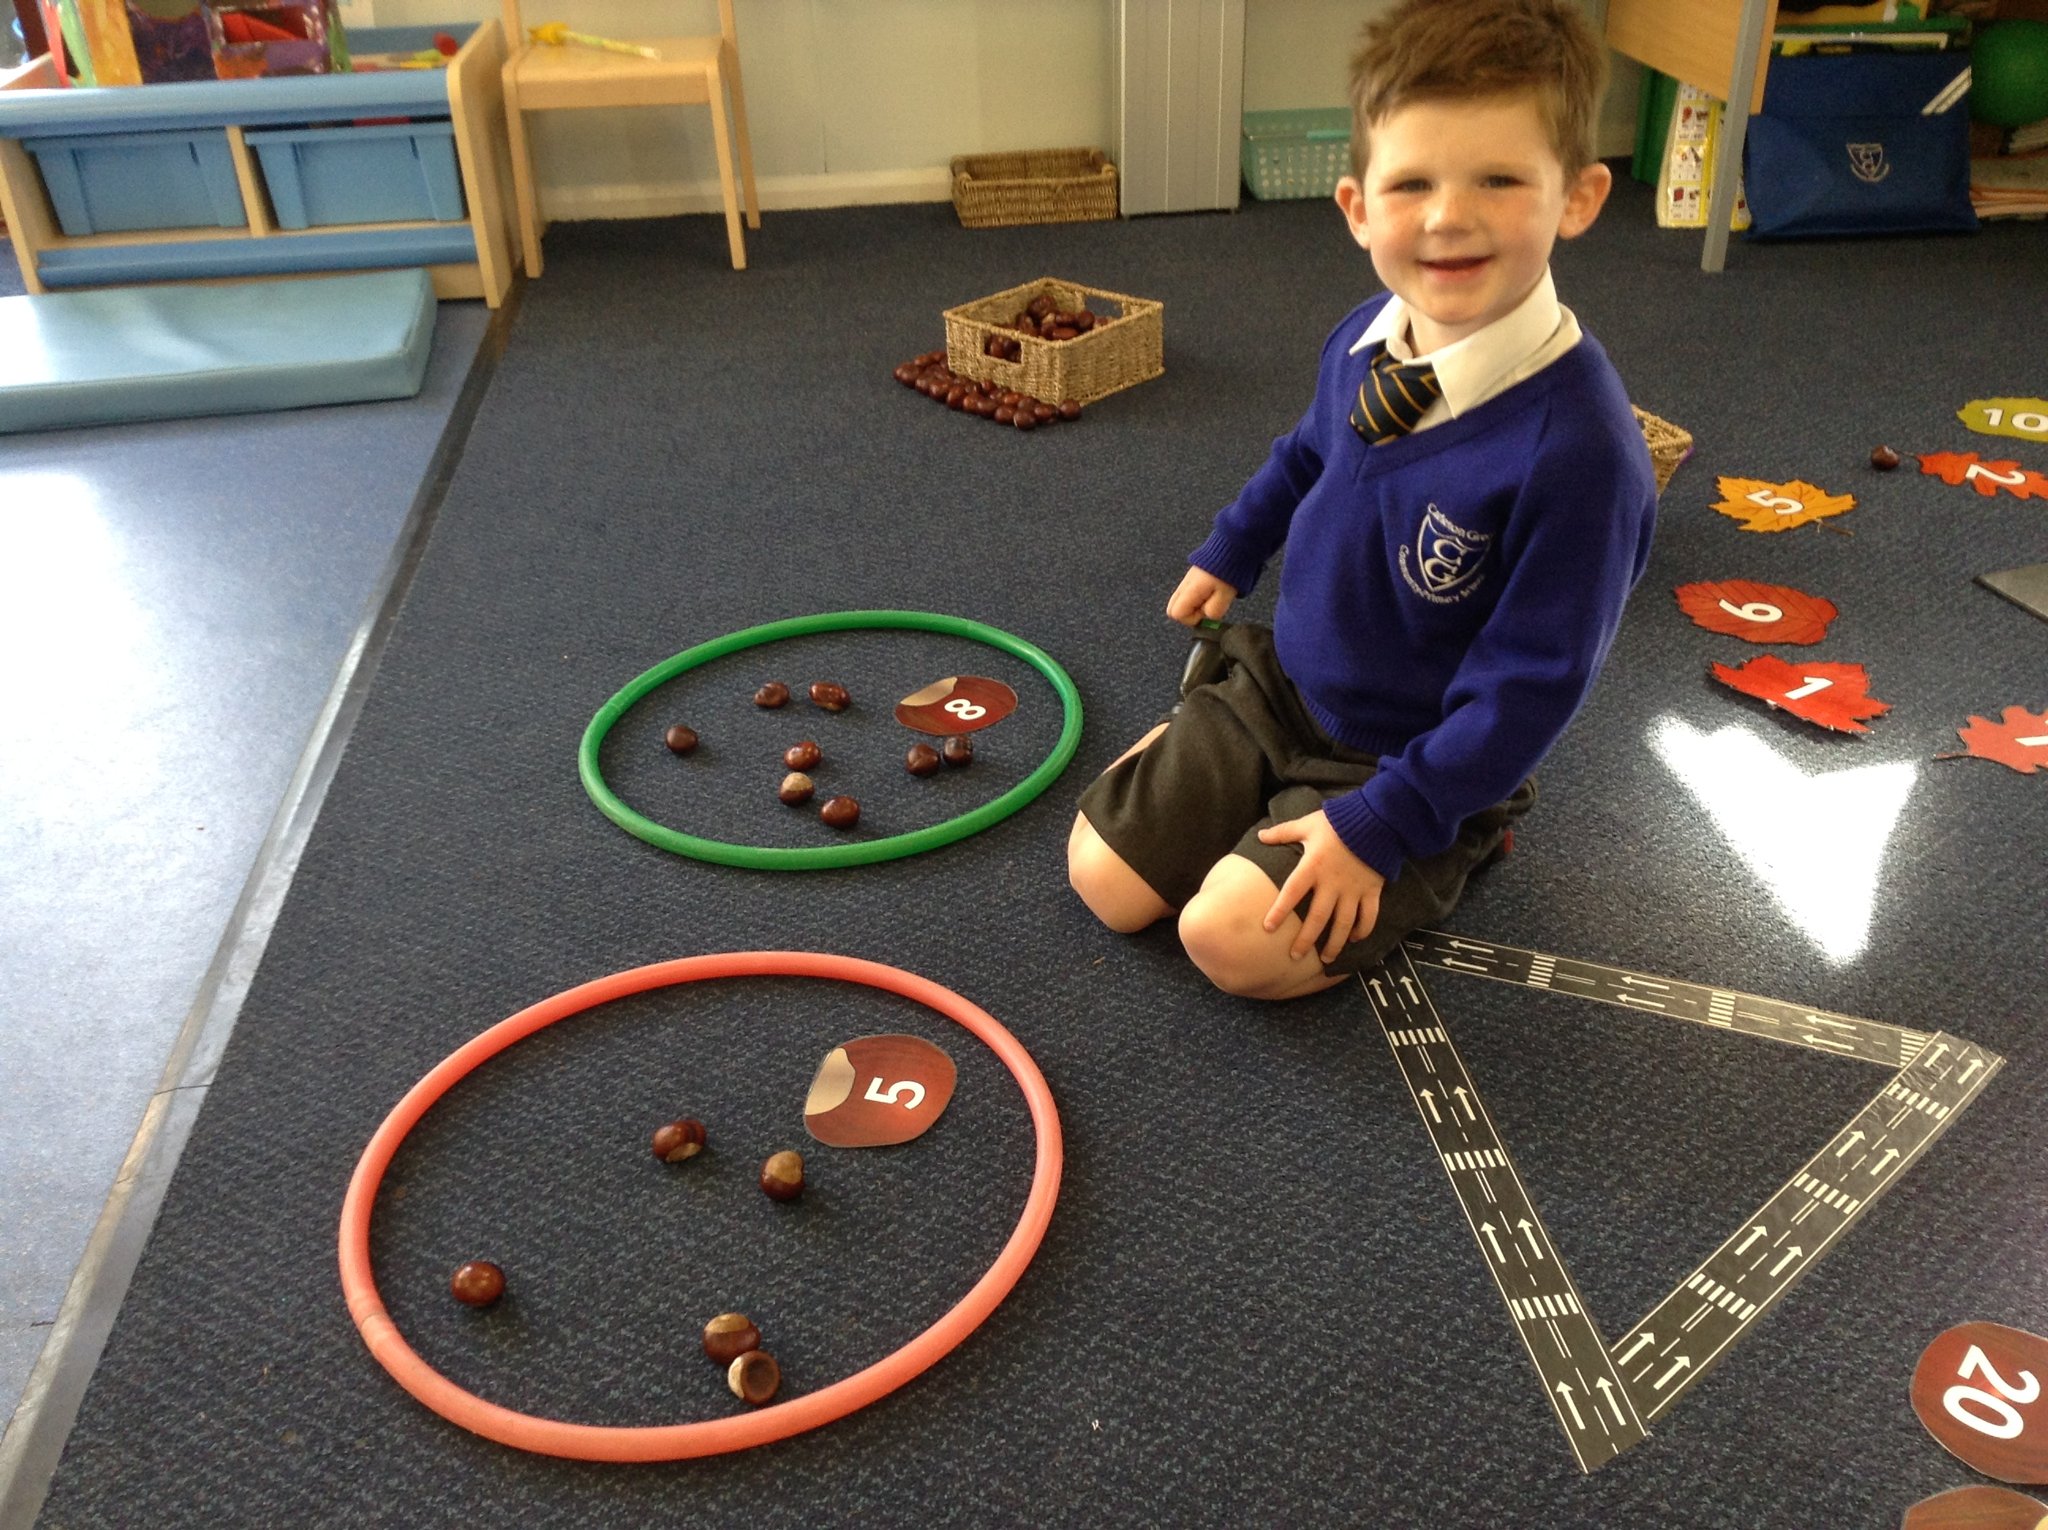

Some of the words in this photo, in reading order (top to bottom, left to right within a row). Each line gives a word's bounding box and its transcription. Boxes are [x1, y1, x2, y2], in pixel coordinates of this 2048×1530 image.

[1983, 407, 2048, 432] 10
[1965, 464, 2026, 485] 2
[1746, 489, 1804, 515] 5
[1718, 598, 1783, 623] 6
[1784, 676, 1834, 699] 1
[944, 698, 987, 721] 8
[863, 1076, 926, 1110] 5
[1942, 1343, 2041, 1440] 20
